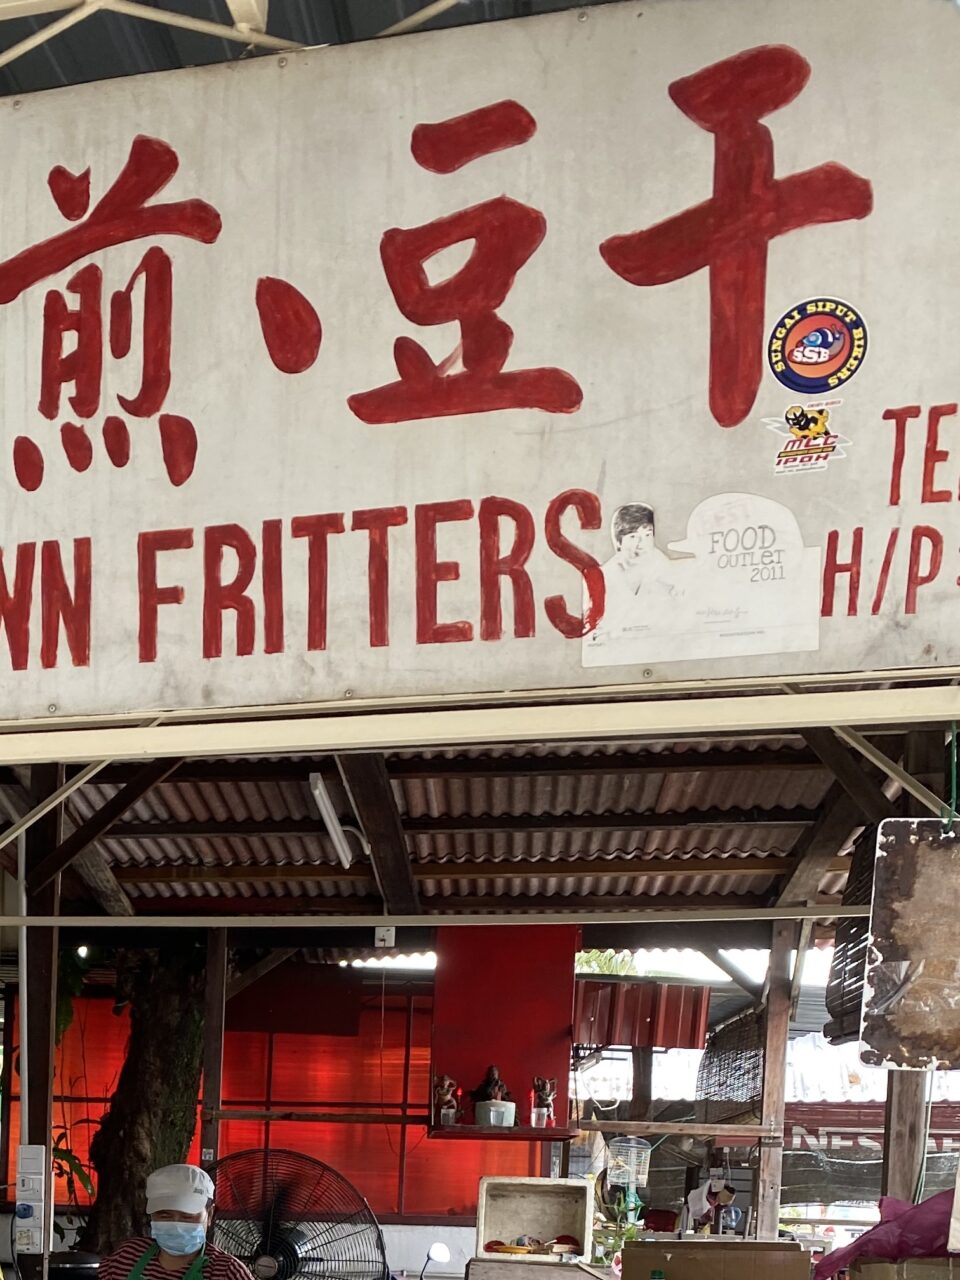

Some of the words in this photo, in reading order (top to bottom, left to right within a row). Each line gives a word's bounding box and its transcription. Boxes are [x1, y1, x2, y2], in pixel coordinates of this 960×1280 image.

[806, 301, 856, 323] SIPUT
[771, 310, 801, 372] SUNGAI
[792, 346, 830, 363] SSB
[828, 327, 864, 387] BIKERS
[776, 453, 830, 466] IPOH
[882, 403, 960, 505] TE
[708, 524, 776, 554] FOOD
[137, 487, 607, 663] FRITTERS
[750, 566, 786, 583] 2011
